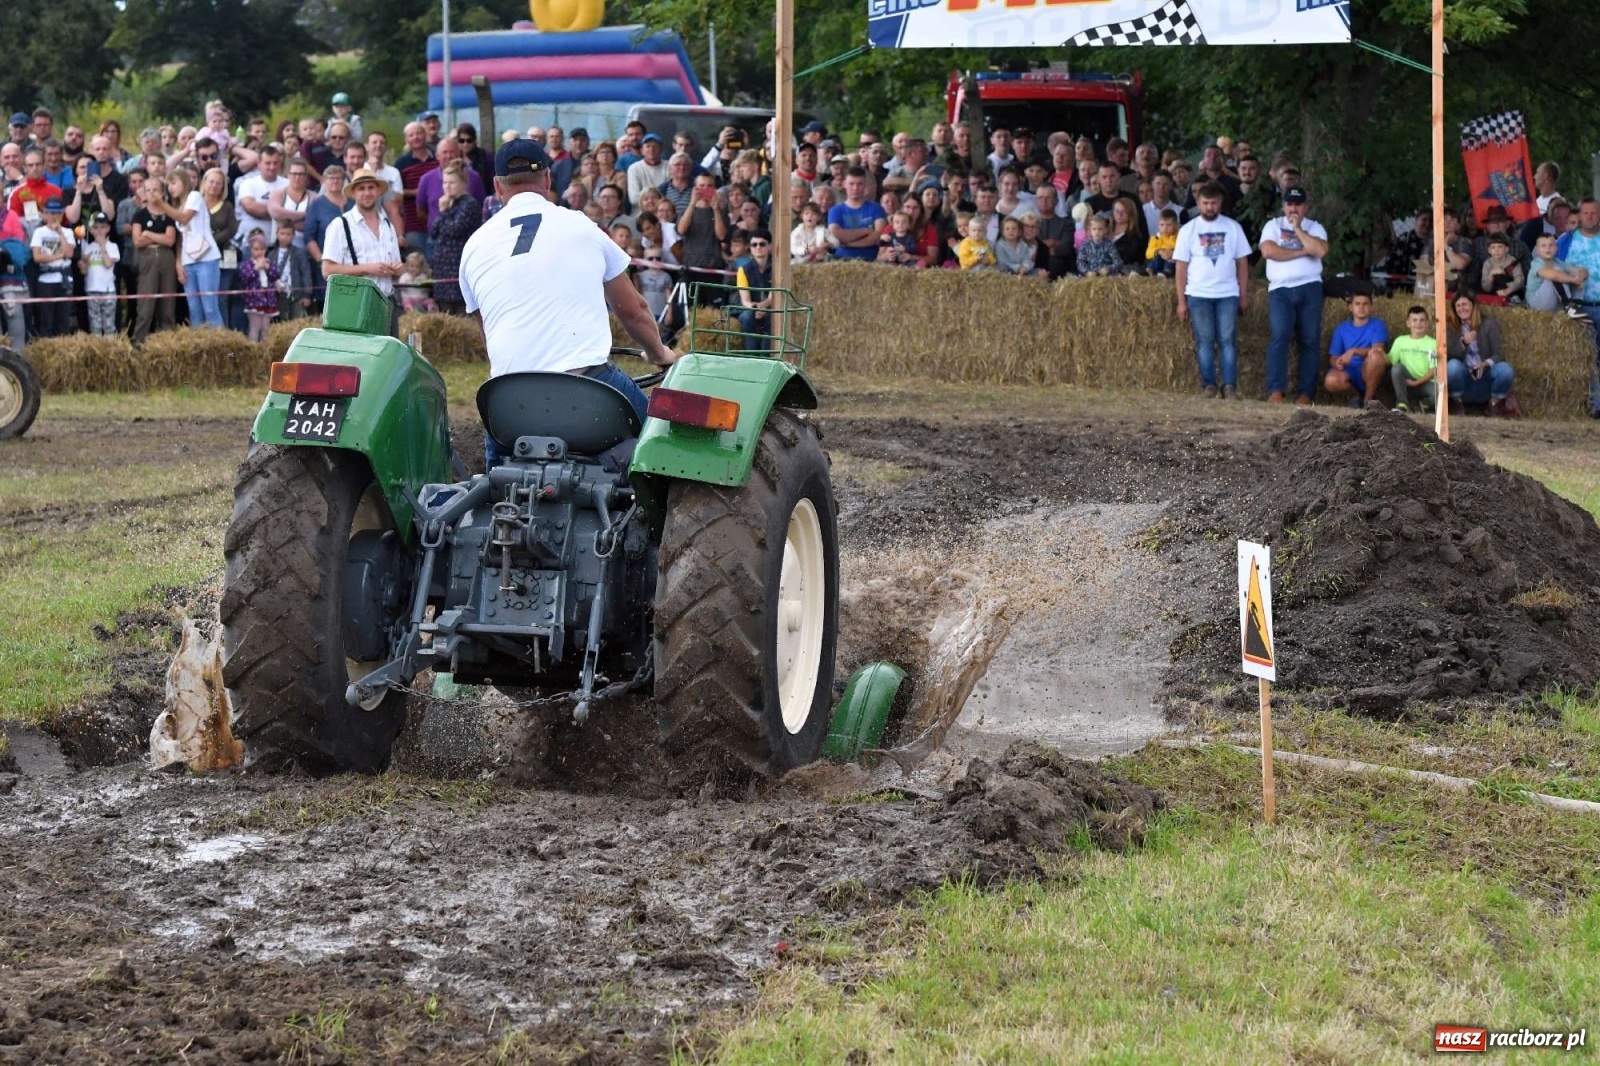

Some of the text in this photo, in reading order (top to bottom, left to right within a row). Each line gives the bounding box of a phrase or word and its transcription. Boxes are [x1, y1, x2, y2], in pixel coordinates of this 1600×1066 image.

[510, 213, 542, 257] 7
[293, 400, 336, 417] KAH
[286, 419, 337, 437] 2042
